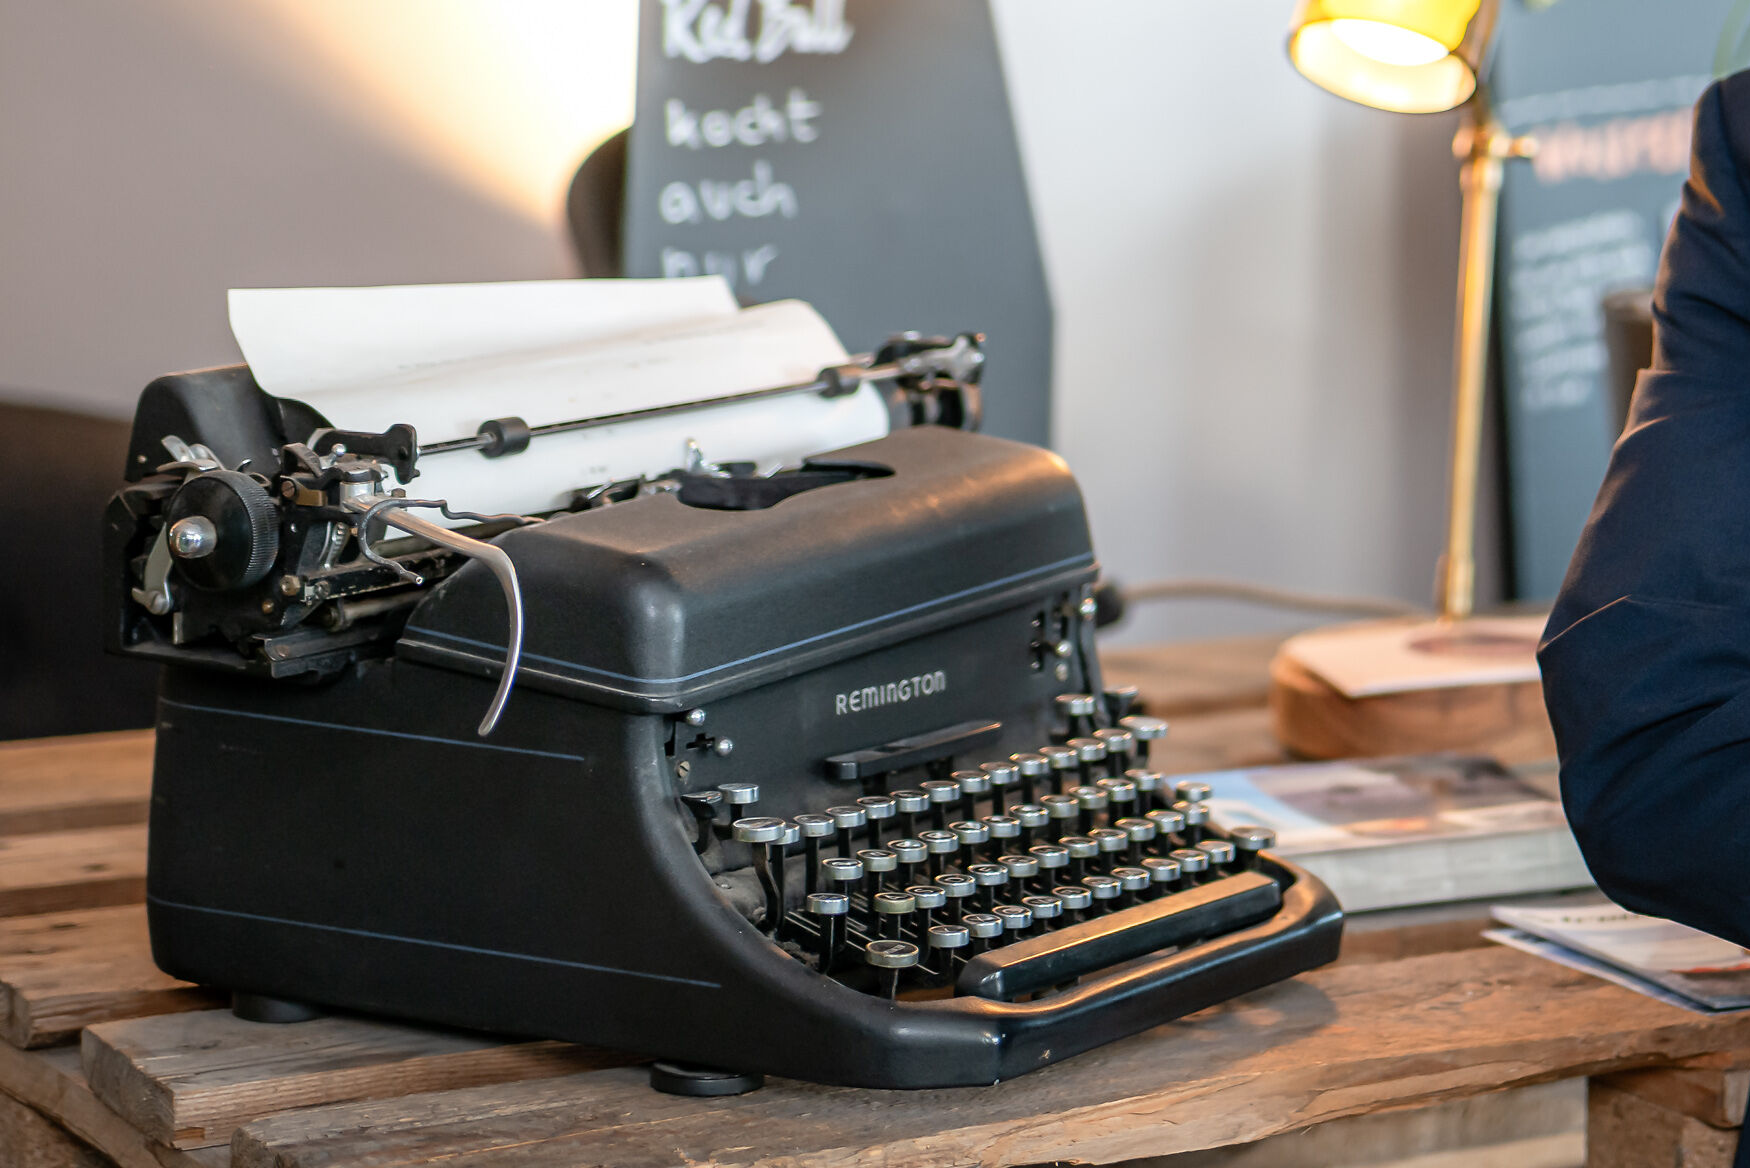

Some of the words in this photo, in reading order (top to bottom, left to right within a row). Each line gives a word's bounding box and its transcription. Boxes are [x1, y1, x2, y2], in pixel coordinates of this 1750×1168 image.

[664, 86, 823, 150] kocht
[659, 158, 797, 226] auch
[836, 670, 946, 716] REMINGTON
